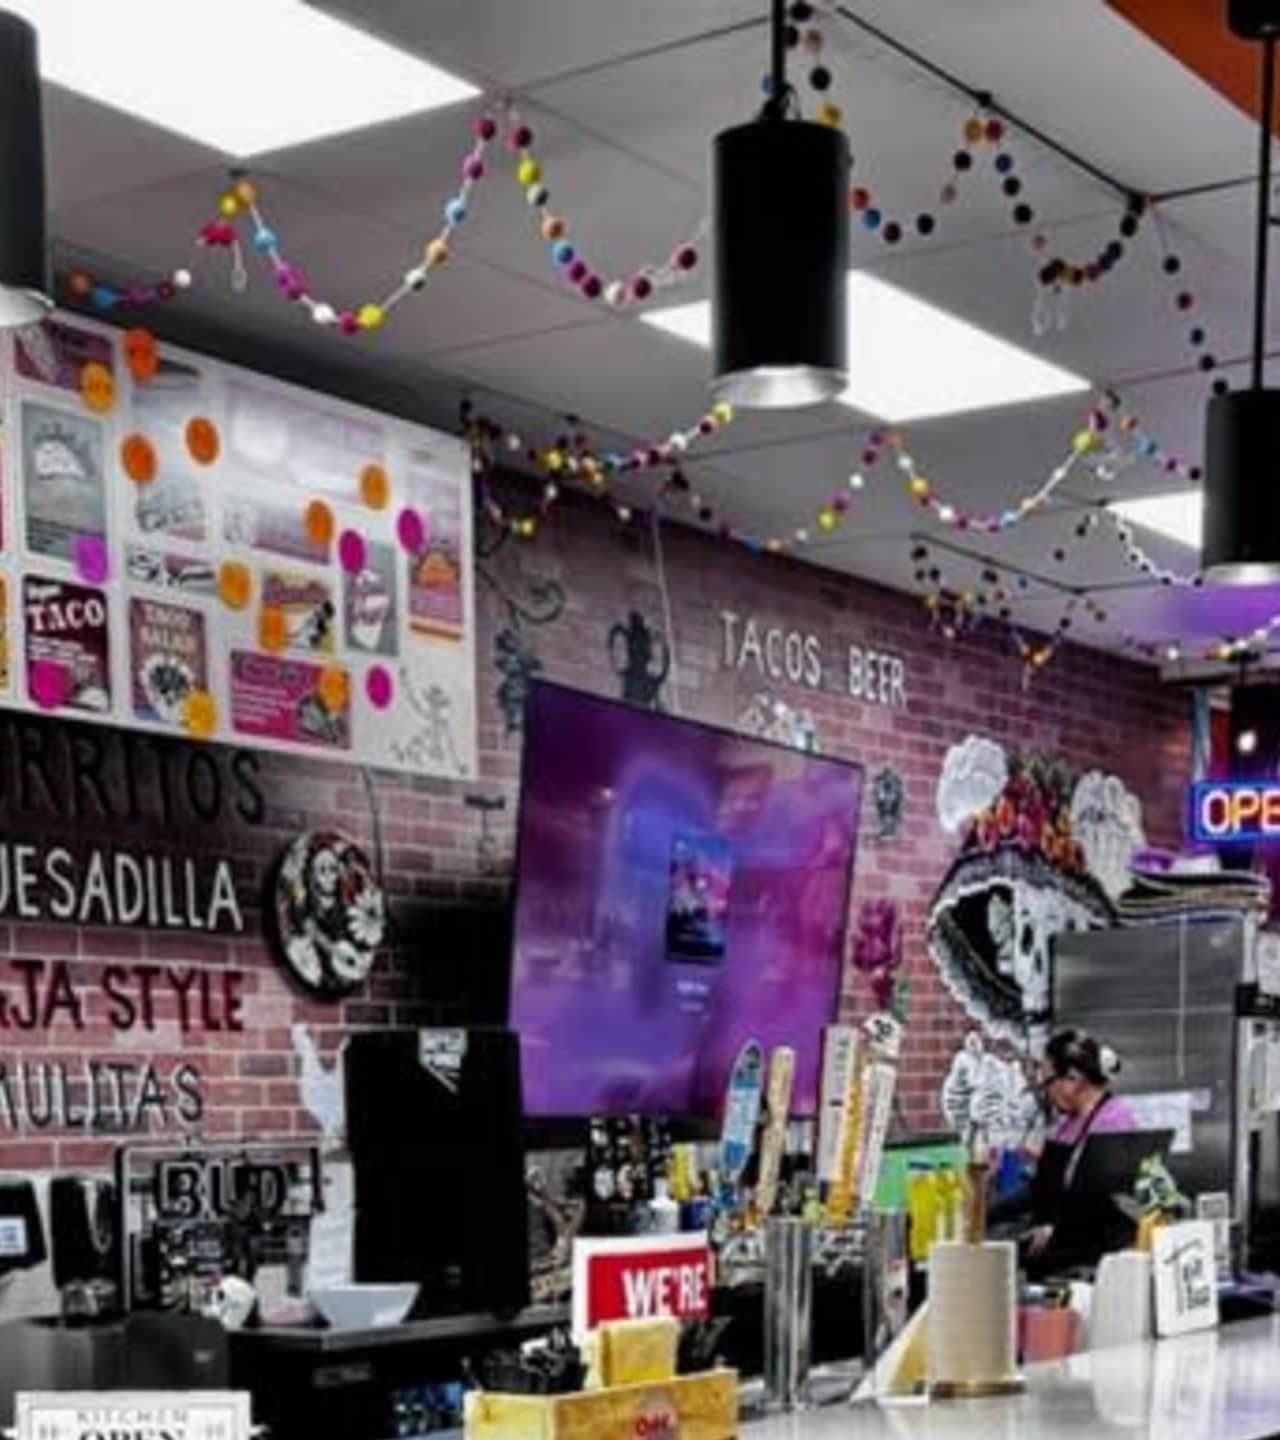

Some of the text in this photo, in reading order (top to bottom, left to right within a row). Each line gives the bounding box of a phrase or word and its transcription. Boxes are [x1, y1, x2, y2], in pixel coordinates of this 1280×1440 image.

[25, 598, 105, 632] TACO
[720, 609, 907, 707] TACOS BEER
[105, 964, 245, 1034] STYLE
[622, 1265, 708, 1317] WE'RE
[76, 1407, 190, 1423] KITCHEN
